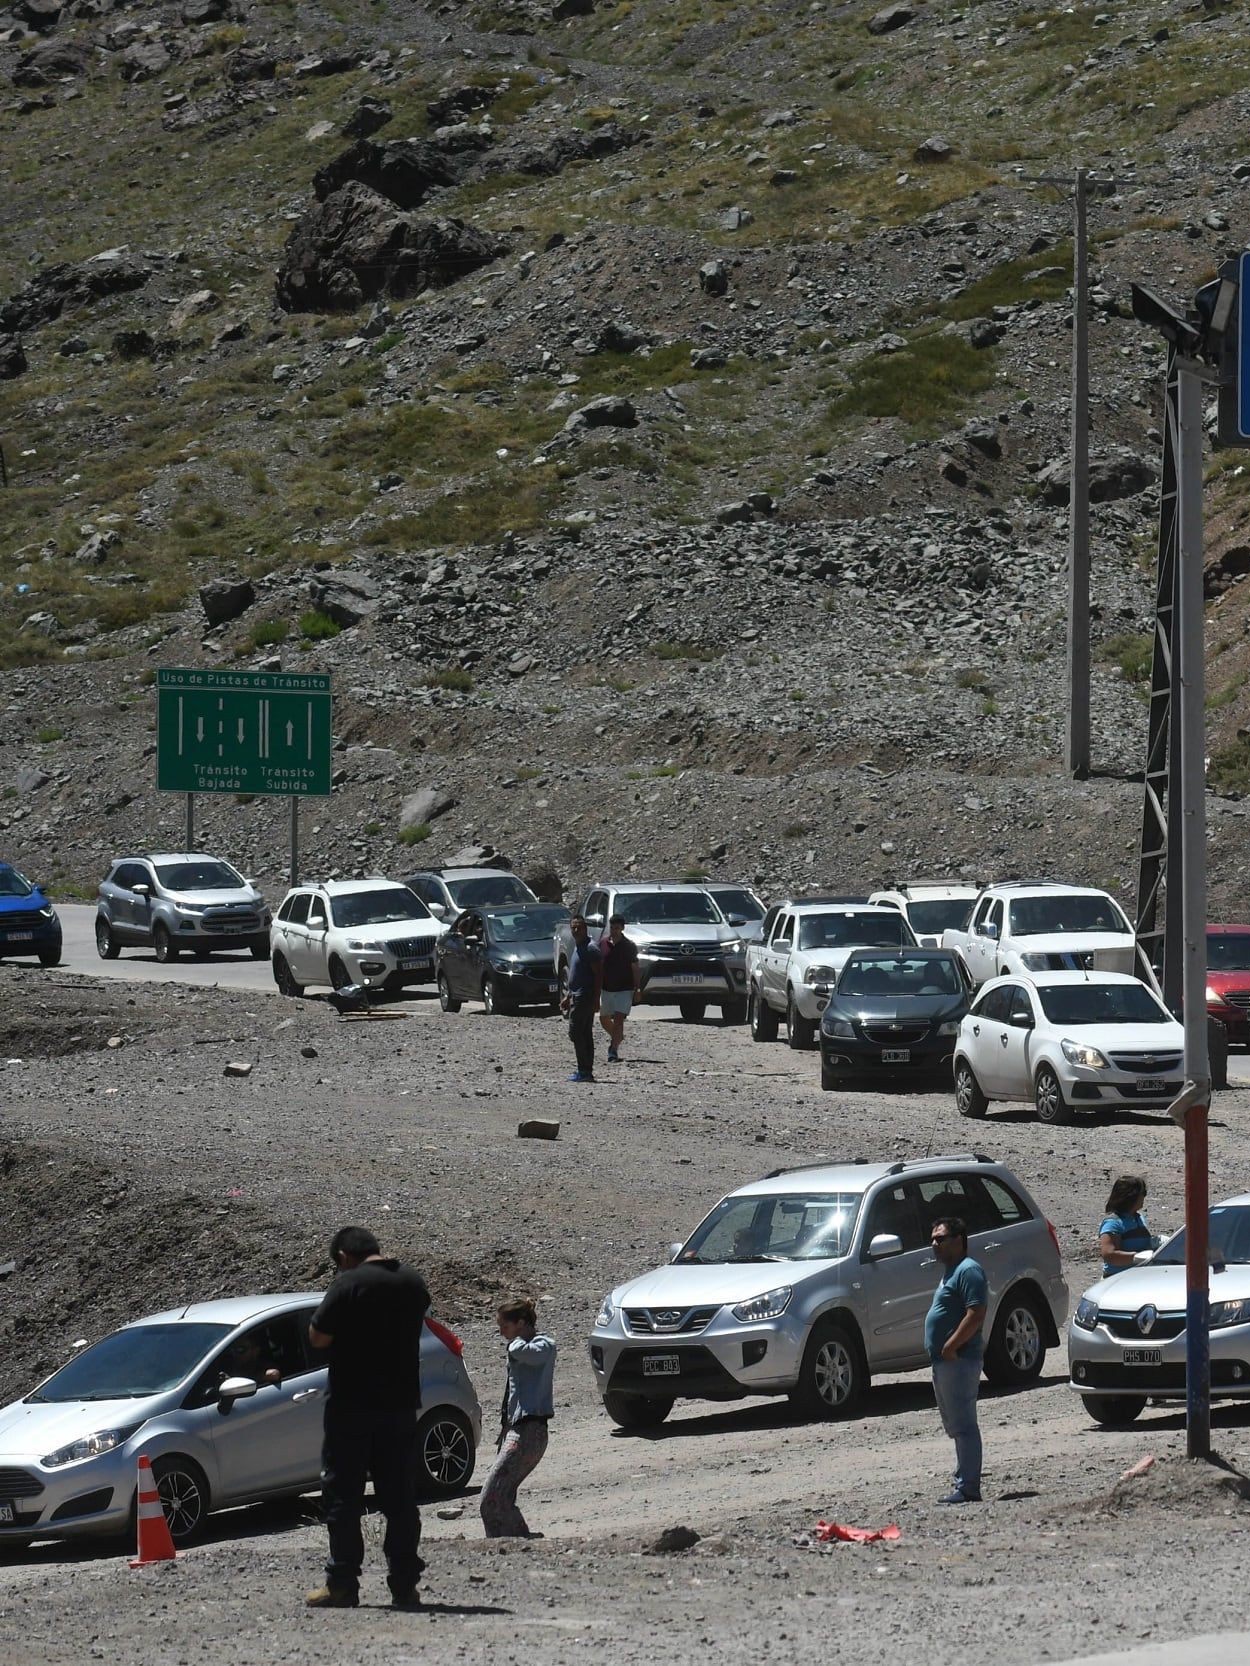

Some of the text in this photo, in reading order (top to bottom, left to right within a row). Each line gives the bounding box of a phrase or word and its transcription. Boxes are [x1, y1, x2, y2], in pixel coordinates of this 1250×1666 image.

[162, 673, 184, 683] Uso
[189, 674, 202, 684] de
[207, 674, 249, 686] Pistas
[253, 676, 267, 686] de
[198, 778, 241, 791] Bajada
[266, 779, 308, 791] Subida
[1124, 1350, 1160, 1361] PHS 070
[644, 1360, 679, 1372] PCC 843
[0, 1508, 12, 1520] SA
